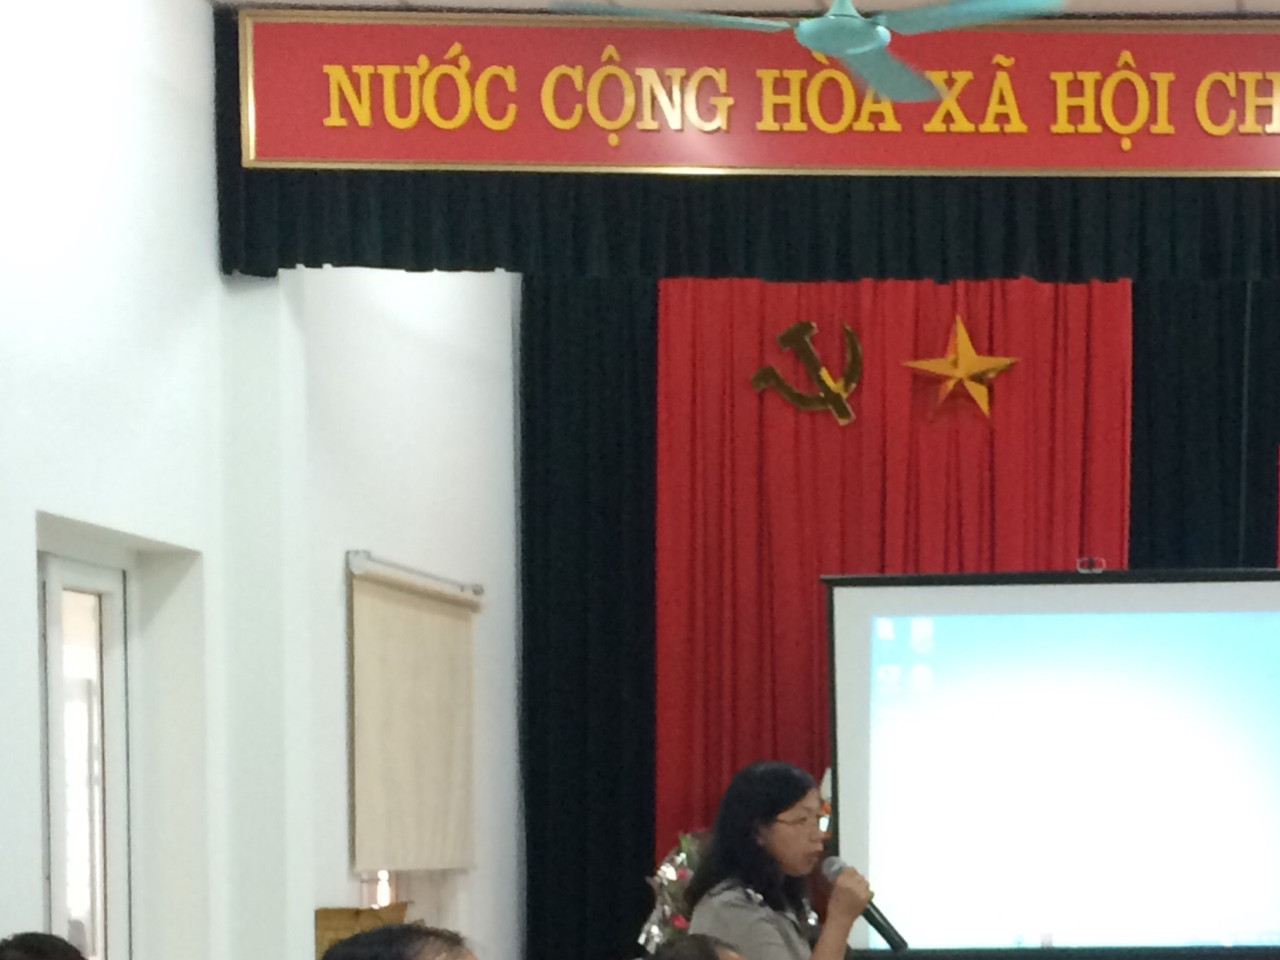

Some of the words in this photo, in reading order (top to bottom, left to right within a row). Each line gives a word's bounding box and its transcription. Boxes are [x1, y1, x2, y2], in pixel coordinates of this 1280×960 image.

[322, 43, 517, 131] NƯỚC
[541, 46, 734, 146] CỘNG
[923, 54, 1027, 134] XÃ
[1050, 50, 1175, 151] HỘI
